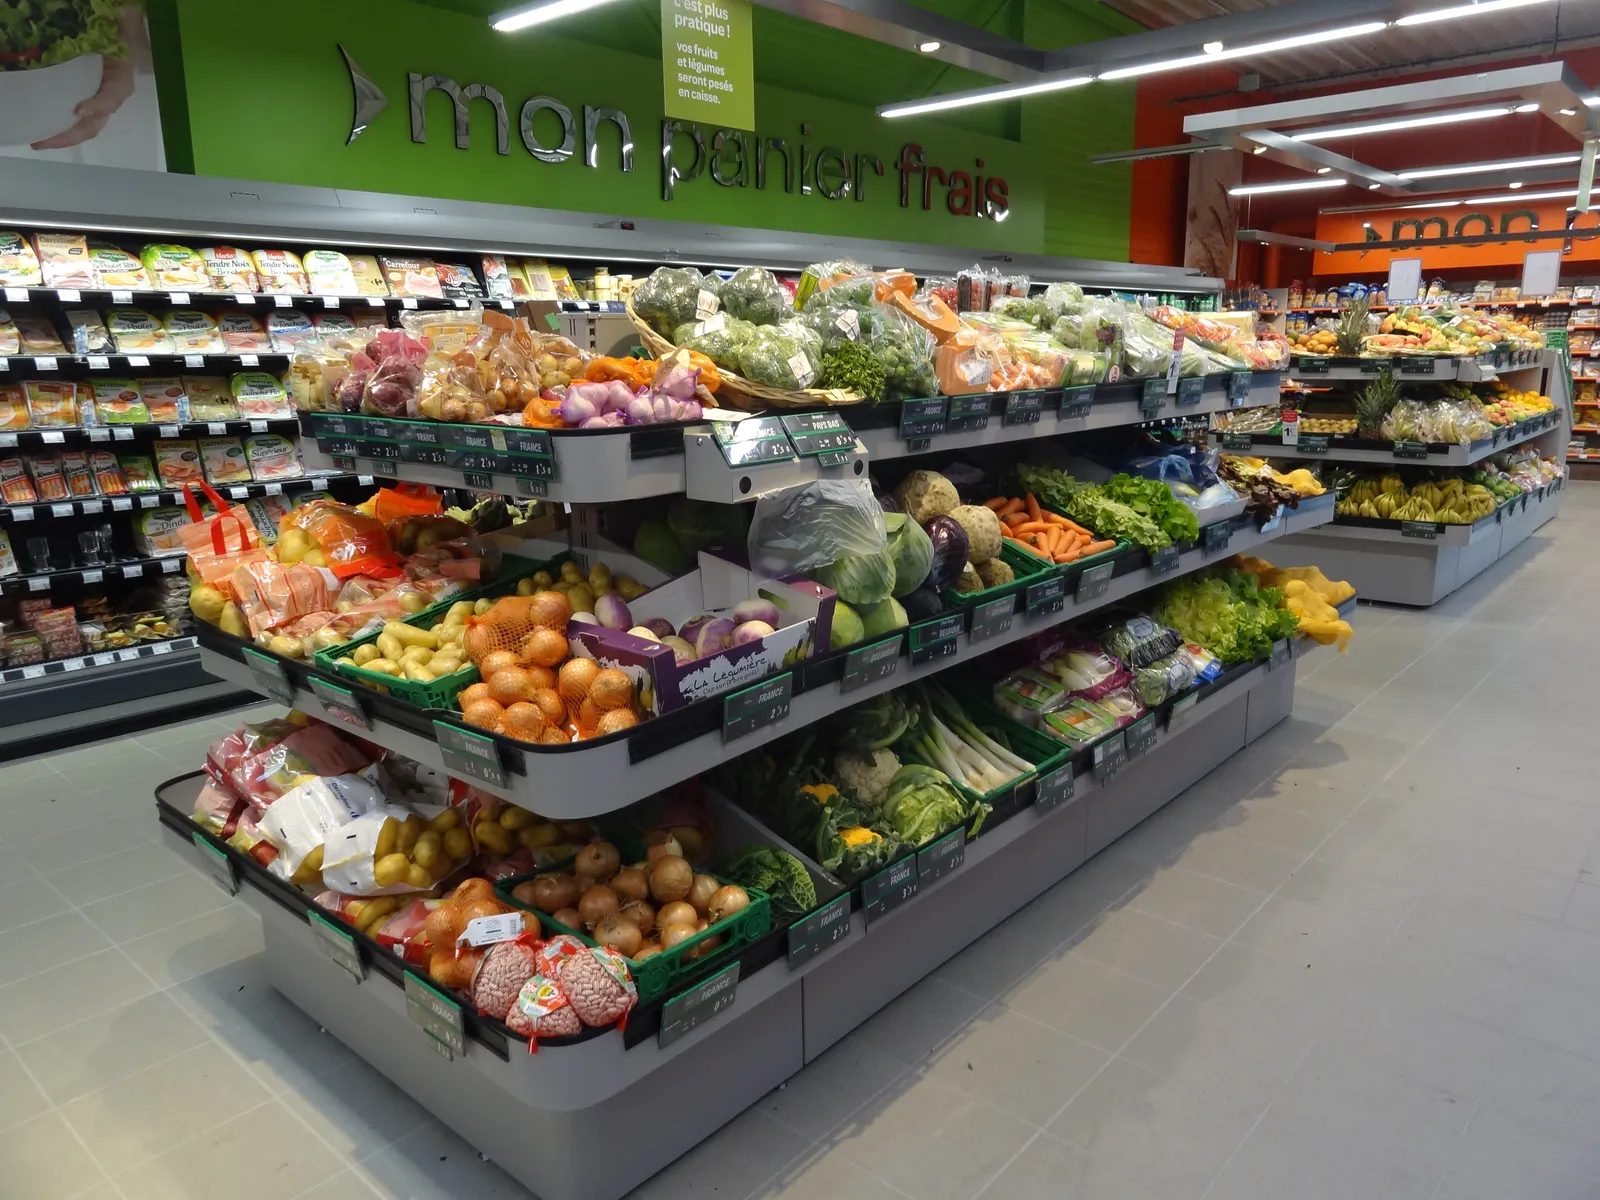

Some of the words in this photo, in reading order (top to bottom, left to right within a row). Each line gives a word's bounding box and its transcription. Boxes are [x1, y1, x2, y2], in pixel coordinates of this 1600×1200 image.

[704, 3, 729, 20] plus
[674, 13, 725, 37] pratique
[676, 42, 693, 54] vos
[694, 44, 719, 60] fruits
[677, 57, 687, 68] et
[688, 57, 725, 76] légumes
[677, 72, 707, 87] seront
[708, 80, 734, 92] pesés
[678, 88, 690, 98] en
[691, 90, 721, 104] caisse.
[407, 71, 635, 172] mon
[661, 119, 884, 202] panier
[897, 143, 1009, 222] frais
[1391, 209, 1540, 252] mon
[205, 260, 230, 268] Tendre
[231, 260, 251, 268] Noix
[385, 260, 420, 269] Carrefour
[813, 421, 828, 430] PAYS
[828, 420, 840, 428] BAS
[417, 433, 437, 442] FRANCE
[465, 436, 487, 447] FRANCE
[520, 441, 543, 453] FRANCE
[713, 654, 767, 683] Légumière
[758, 686, 784, 704] FRANCE
[465, 742, 490, 759] FRANCE
[331, 782, 352, 810] Carrefour
[941, 839, 959, 856] FRANCE
[890, 867, 911, 886] FRANCE
[820, 906, 844, 928] FRANCE
[701, 977, 731, 1002] FRANCE
[432, 1002, 455, 1024] FRANCE
